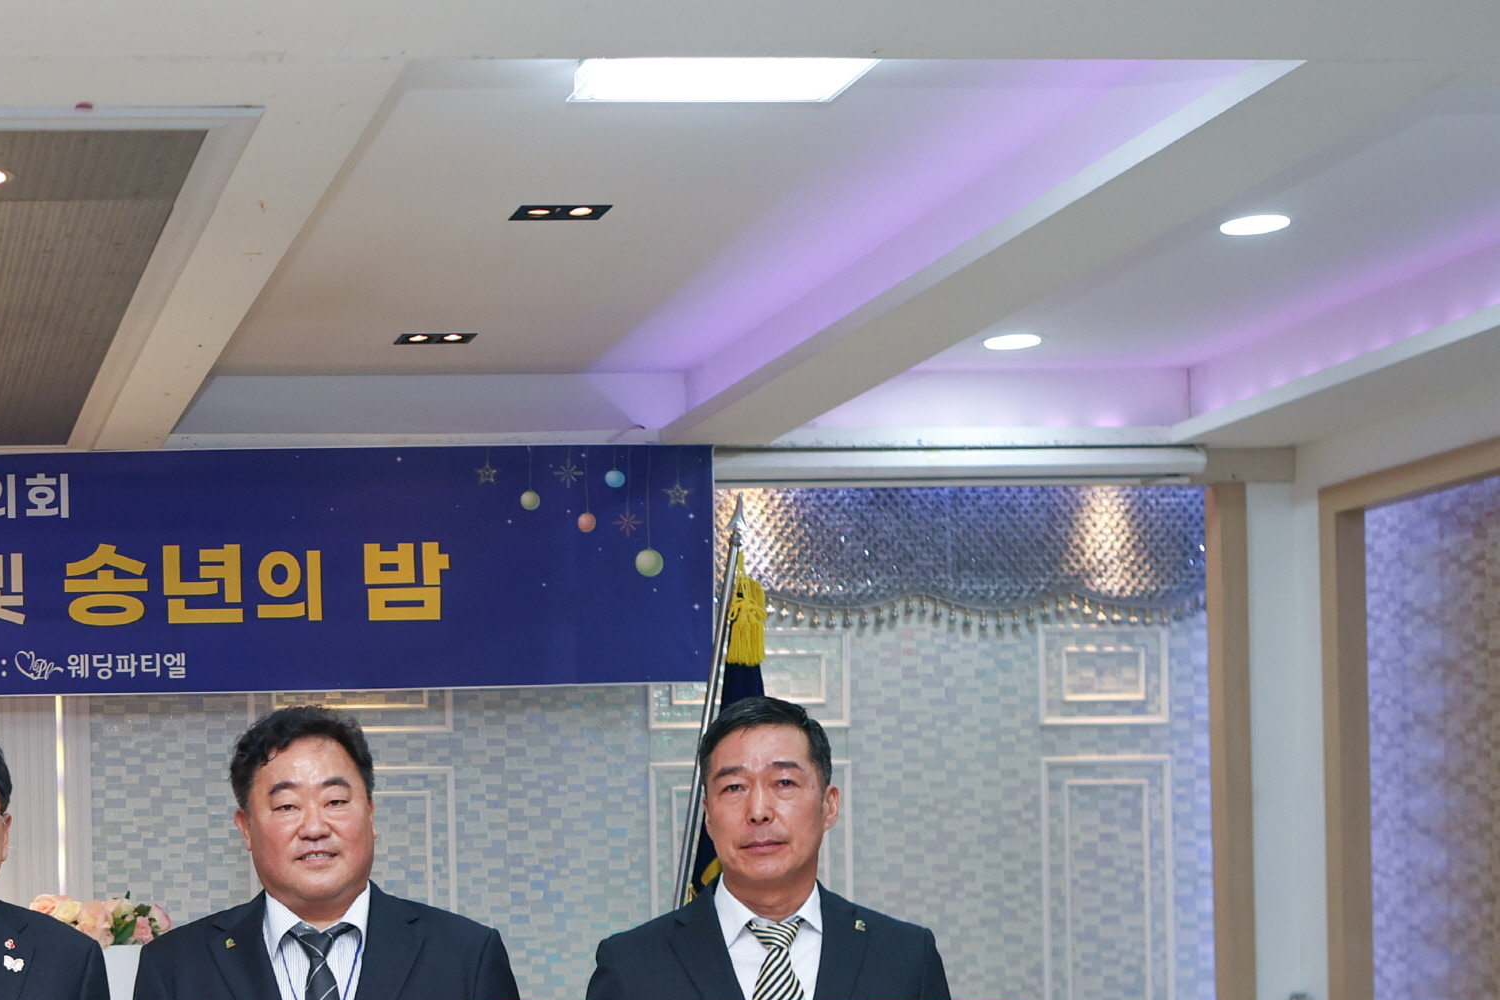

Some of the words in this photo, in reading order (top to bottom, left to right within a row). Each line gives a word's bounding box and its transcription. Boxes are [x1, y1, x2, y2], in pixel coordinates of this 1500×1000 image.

[64, 544, 322, 626] 송년의
[364, 542, 449, 621] 밤
[67, 653, 185, 679] 웨딩파티엘
